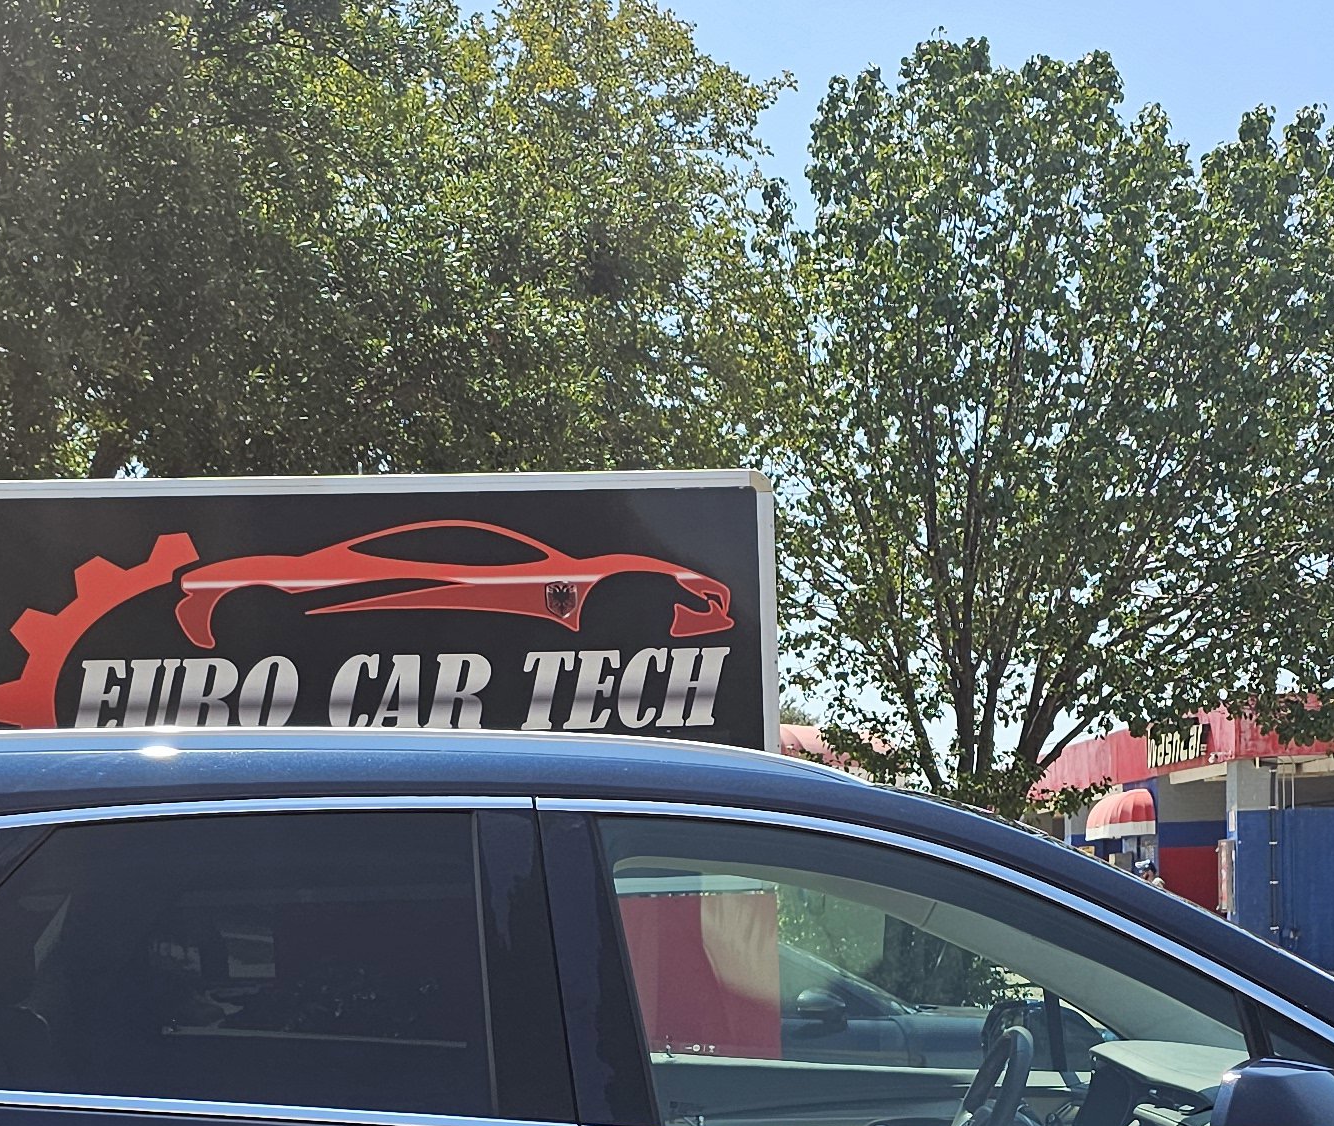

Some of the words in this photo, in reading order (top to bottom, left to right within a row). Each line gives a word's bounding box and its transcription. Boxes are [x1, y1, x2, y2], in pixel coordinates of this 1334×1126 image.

[75, 655, 299, 728] EURO
[328, 653, 492, 729] CAR
[521, 647, 730, 730] TECH
